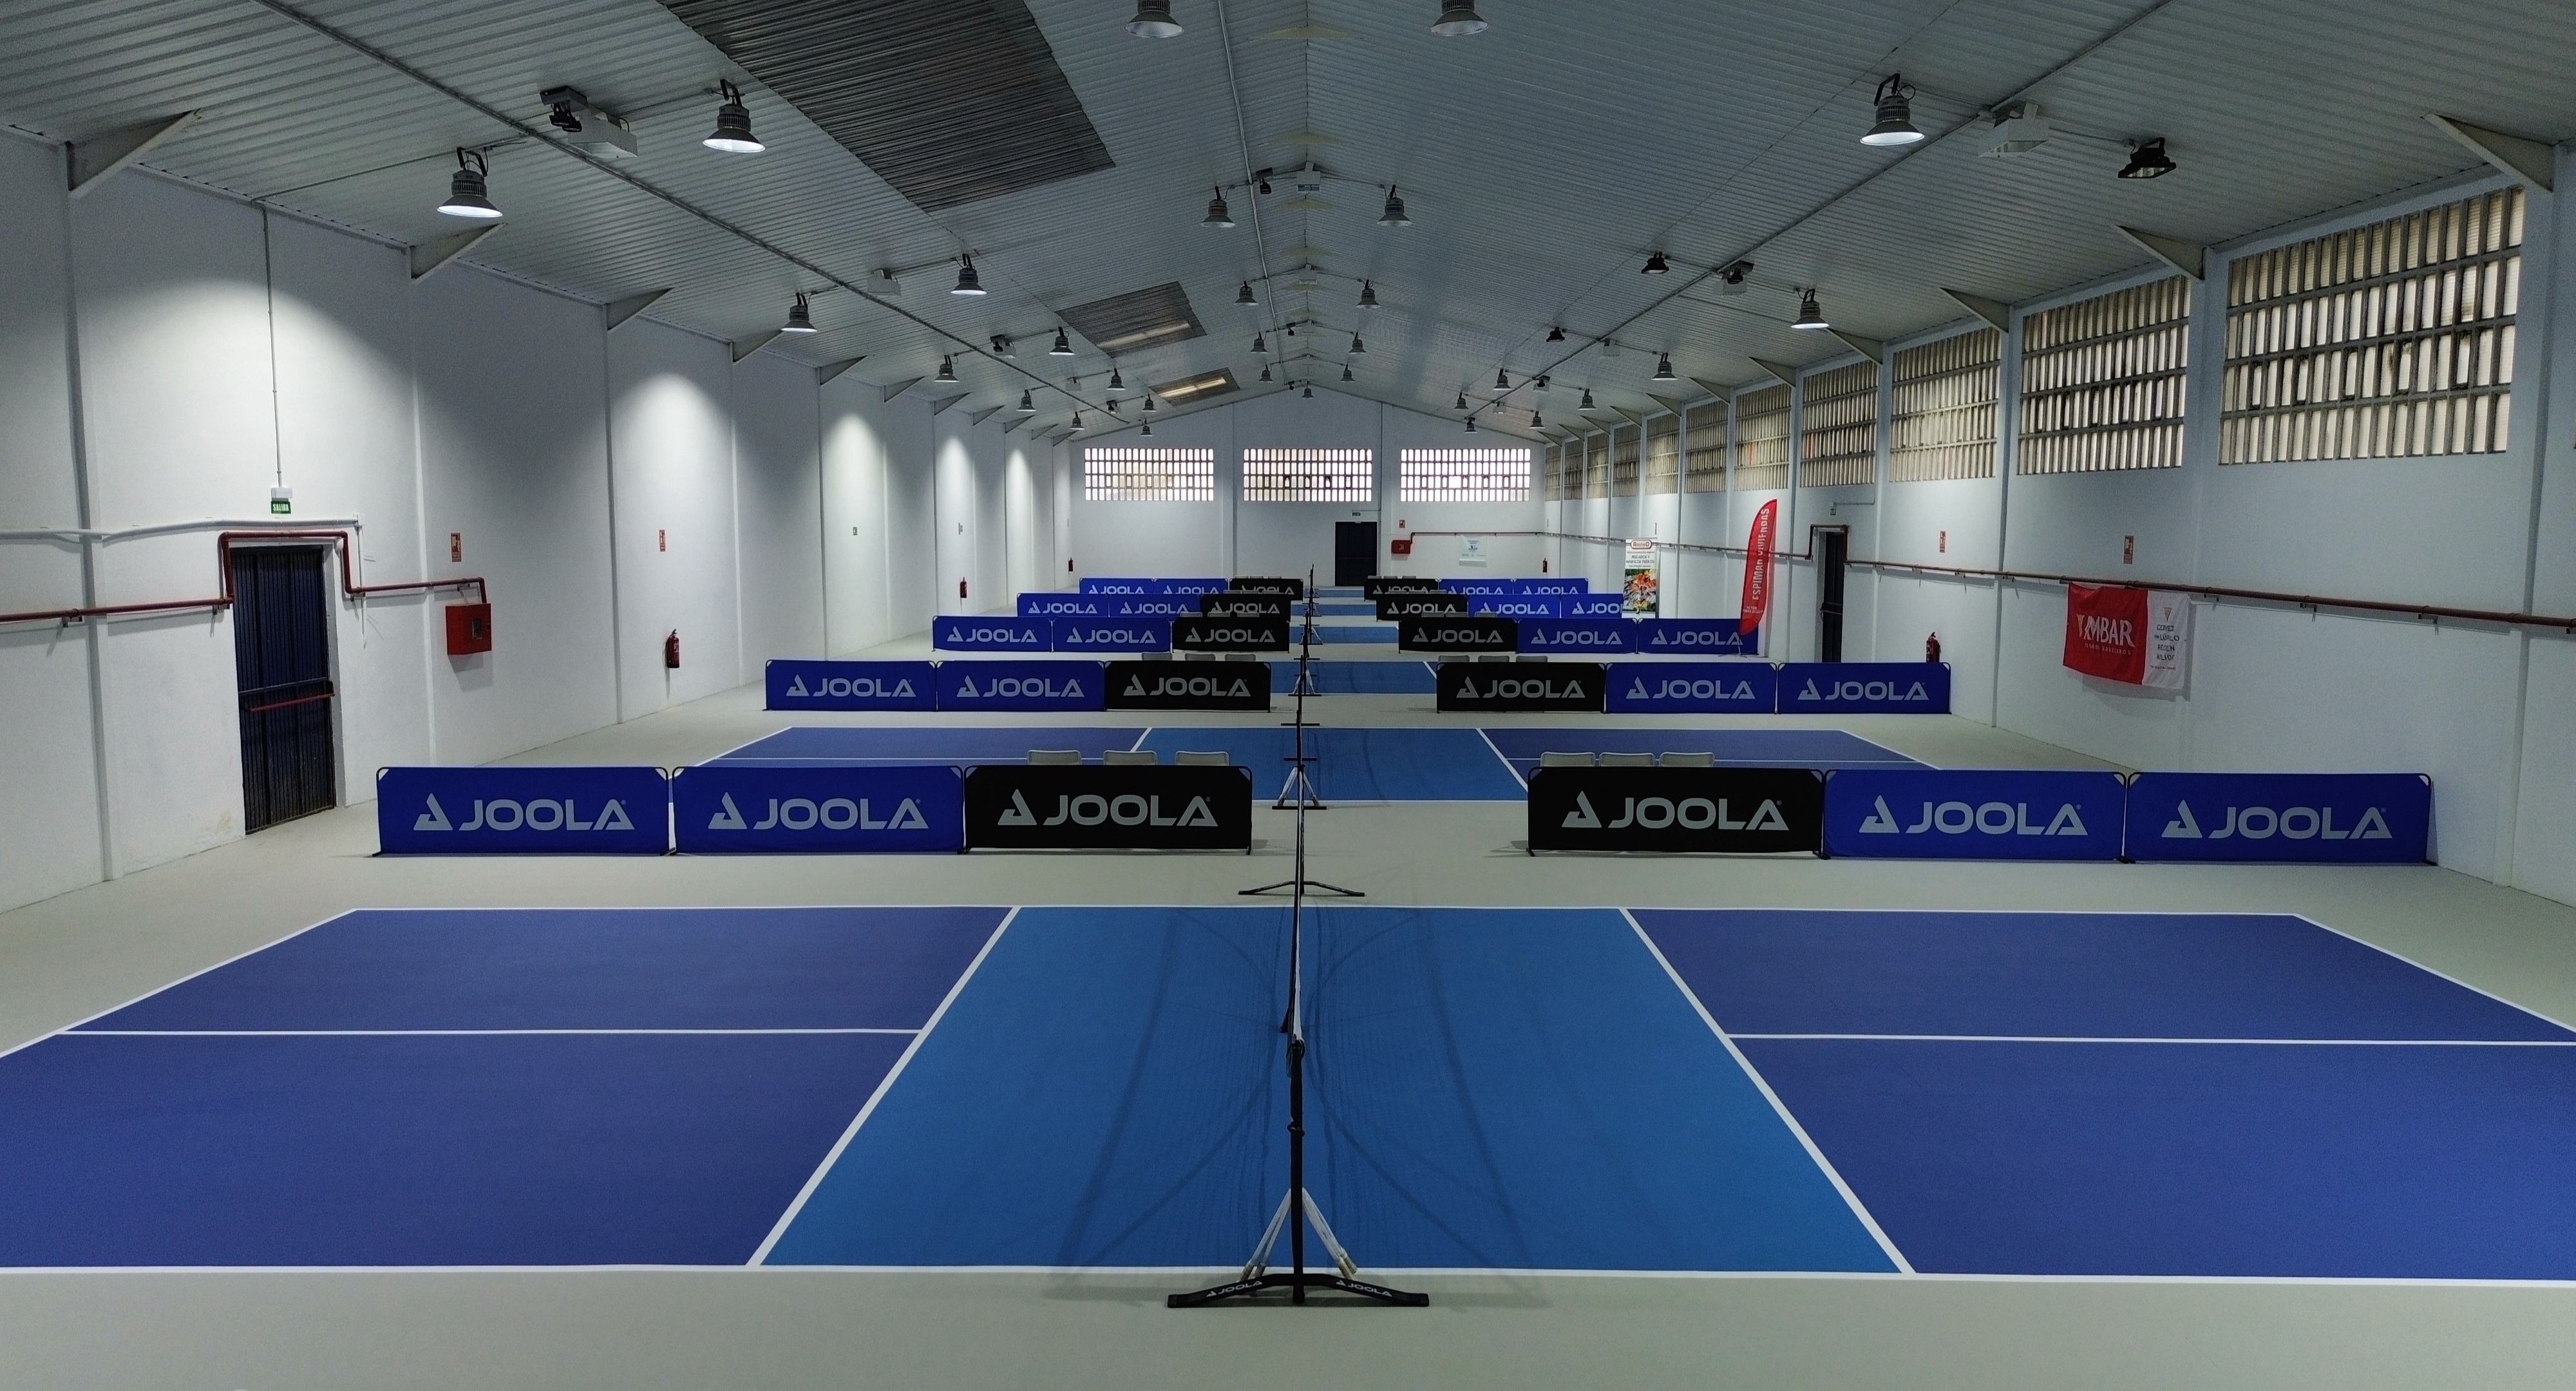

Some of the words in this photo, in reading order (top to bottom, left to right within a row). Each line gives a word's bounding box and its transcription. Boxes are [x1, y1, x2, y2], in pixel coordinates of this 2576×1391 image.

[1101, 586, 1145, 594] JOOLA
[1175, 586, 1219, 594] JOOLA
[1459, 587, 1504, 595] JOOLA
[1042, 603, 1097, 614] JOOLA
[1134, 603, 1189, 614] JOOLA
[1226, 603, 1281, 614] JOOLA
[1401, 603, 1456, 614] JOOLA
[1495, 603, 1549, 615] JOOLA
[1586, 603, 1622, 614] JOO
[966, 629, 1038, 643] JOOLA
[1084, 629, 1157, 644] JOOLA
[1204, 629, 1276, 643] JOOLA
[1430, 629, 1504, 643] JOOLA
[1549, 630, 1623, 645] JOOLA
[1670, 631, 1743, 645] JOOLA
[2083, 615, 2136, 648] AMBAR
[812, 678, 916, 697] JOOLA
[983, 678, 1085, 697] JOOLA
[1149, 677, 1251, 696] JOOLA
[1482, 679, 1586, 699] JOOLA
[1652, 679, 1756, 699] JOOLA
[1824, 681, 1929, 701] JOOLA
[459, 799, 635, 831] JOOLA
[753, 799, 929, 830] JOOLA
[1042, 795, 1218, 827] JOOLA
[1607, 797, 1790, 831] JOOLA
[1905, 802, 2088, 836] JOOLA
[2208, 807, 2393, 840] JOOLA
[1217, 1280, 1263, 1295] JOOLA
[1349, 1282, 1392, 1297] JOOLA
